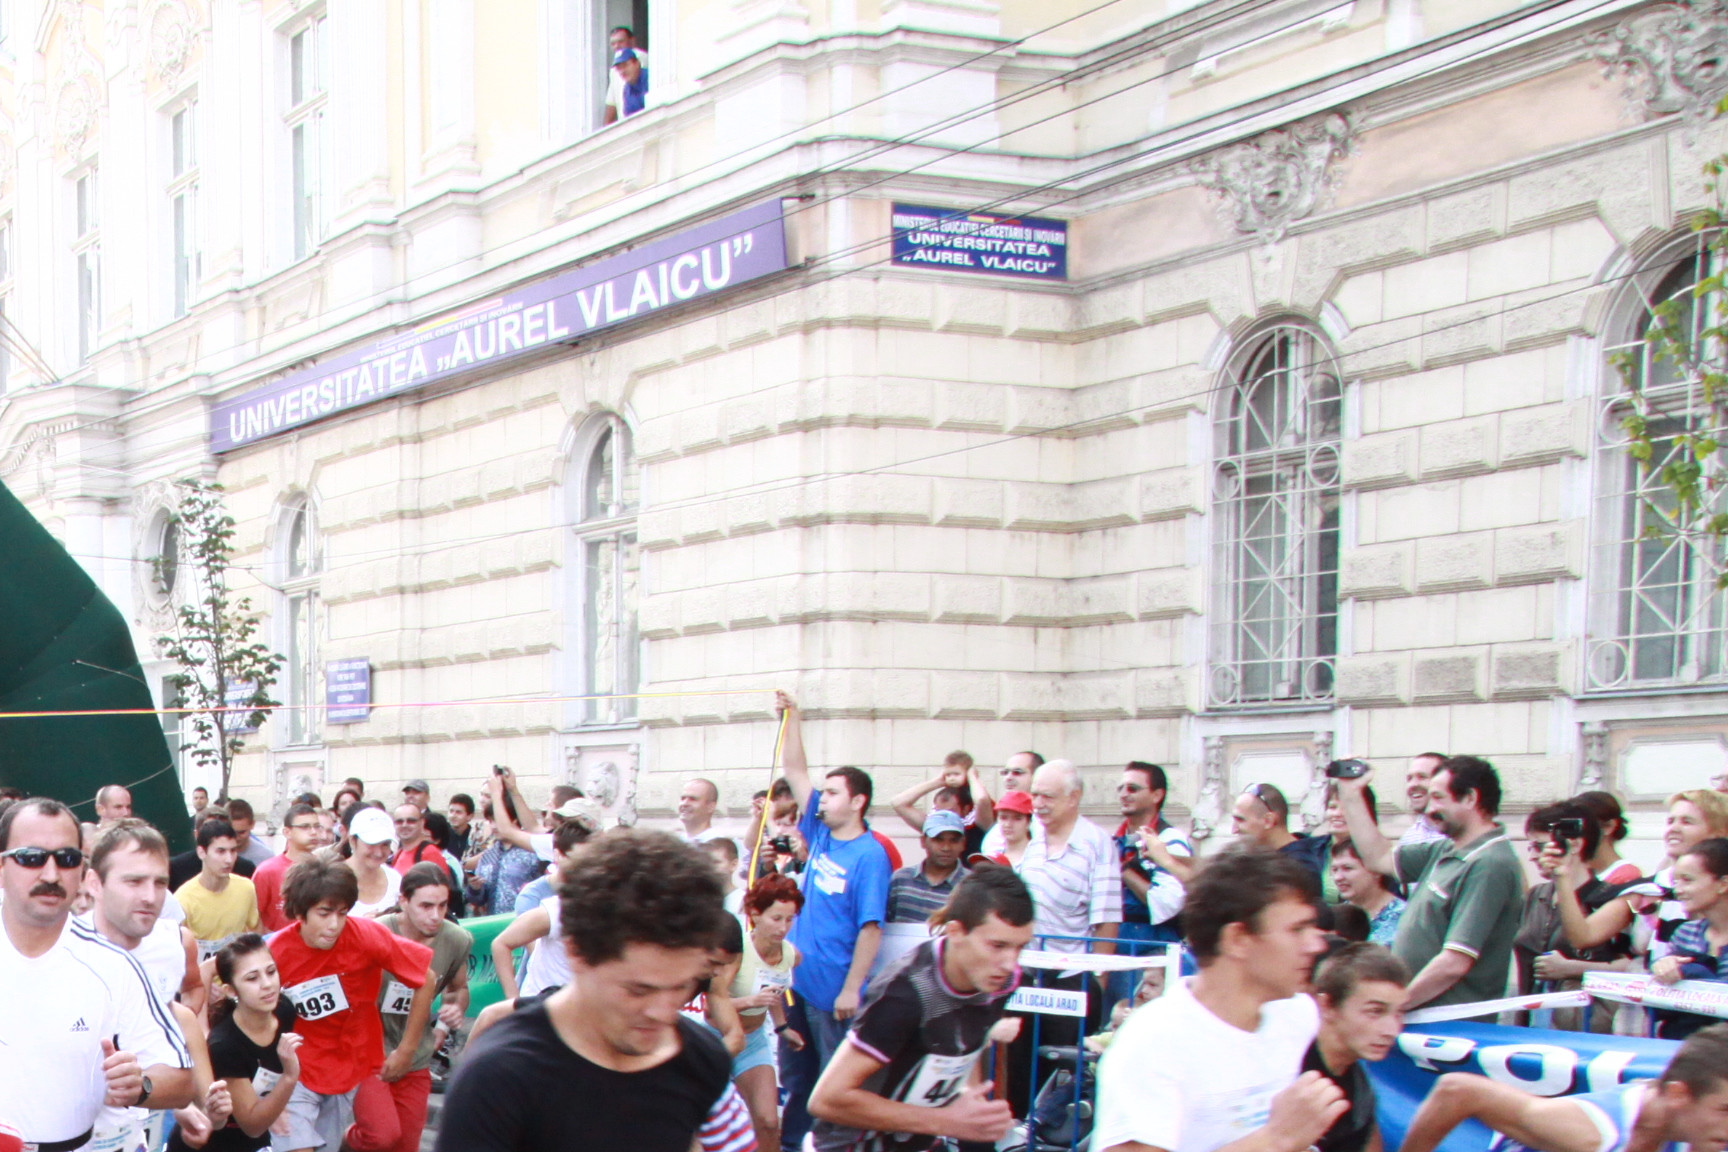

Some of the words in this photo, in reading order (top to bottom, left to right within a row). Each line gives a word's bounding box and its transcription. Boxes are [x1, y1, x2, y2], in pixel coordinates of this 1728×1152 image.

[907, 232, 1052, 258] UNIVERSITATEA
[229, 346, 428, 443] UNIVERSITATEA
[295, 992, 336, 1018] 493
